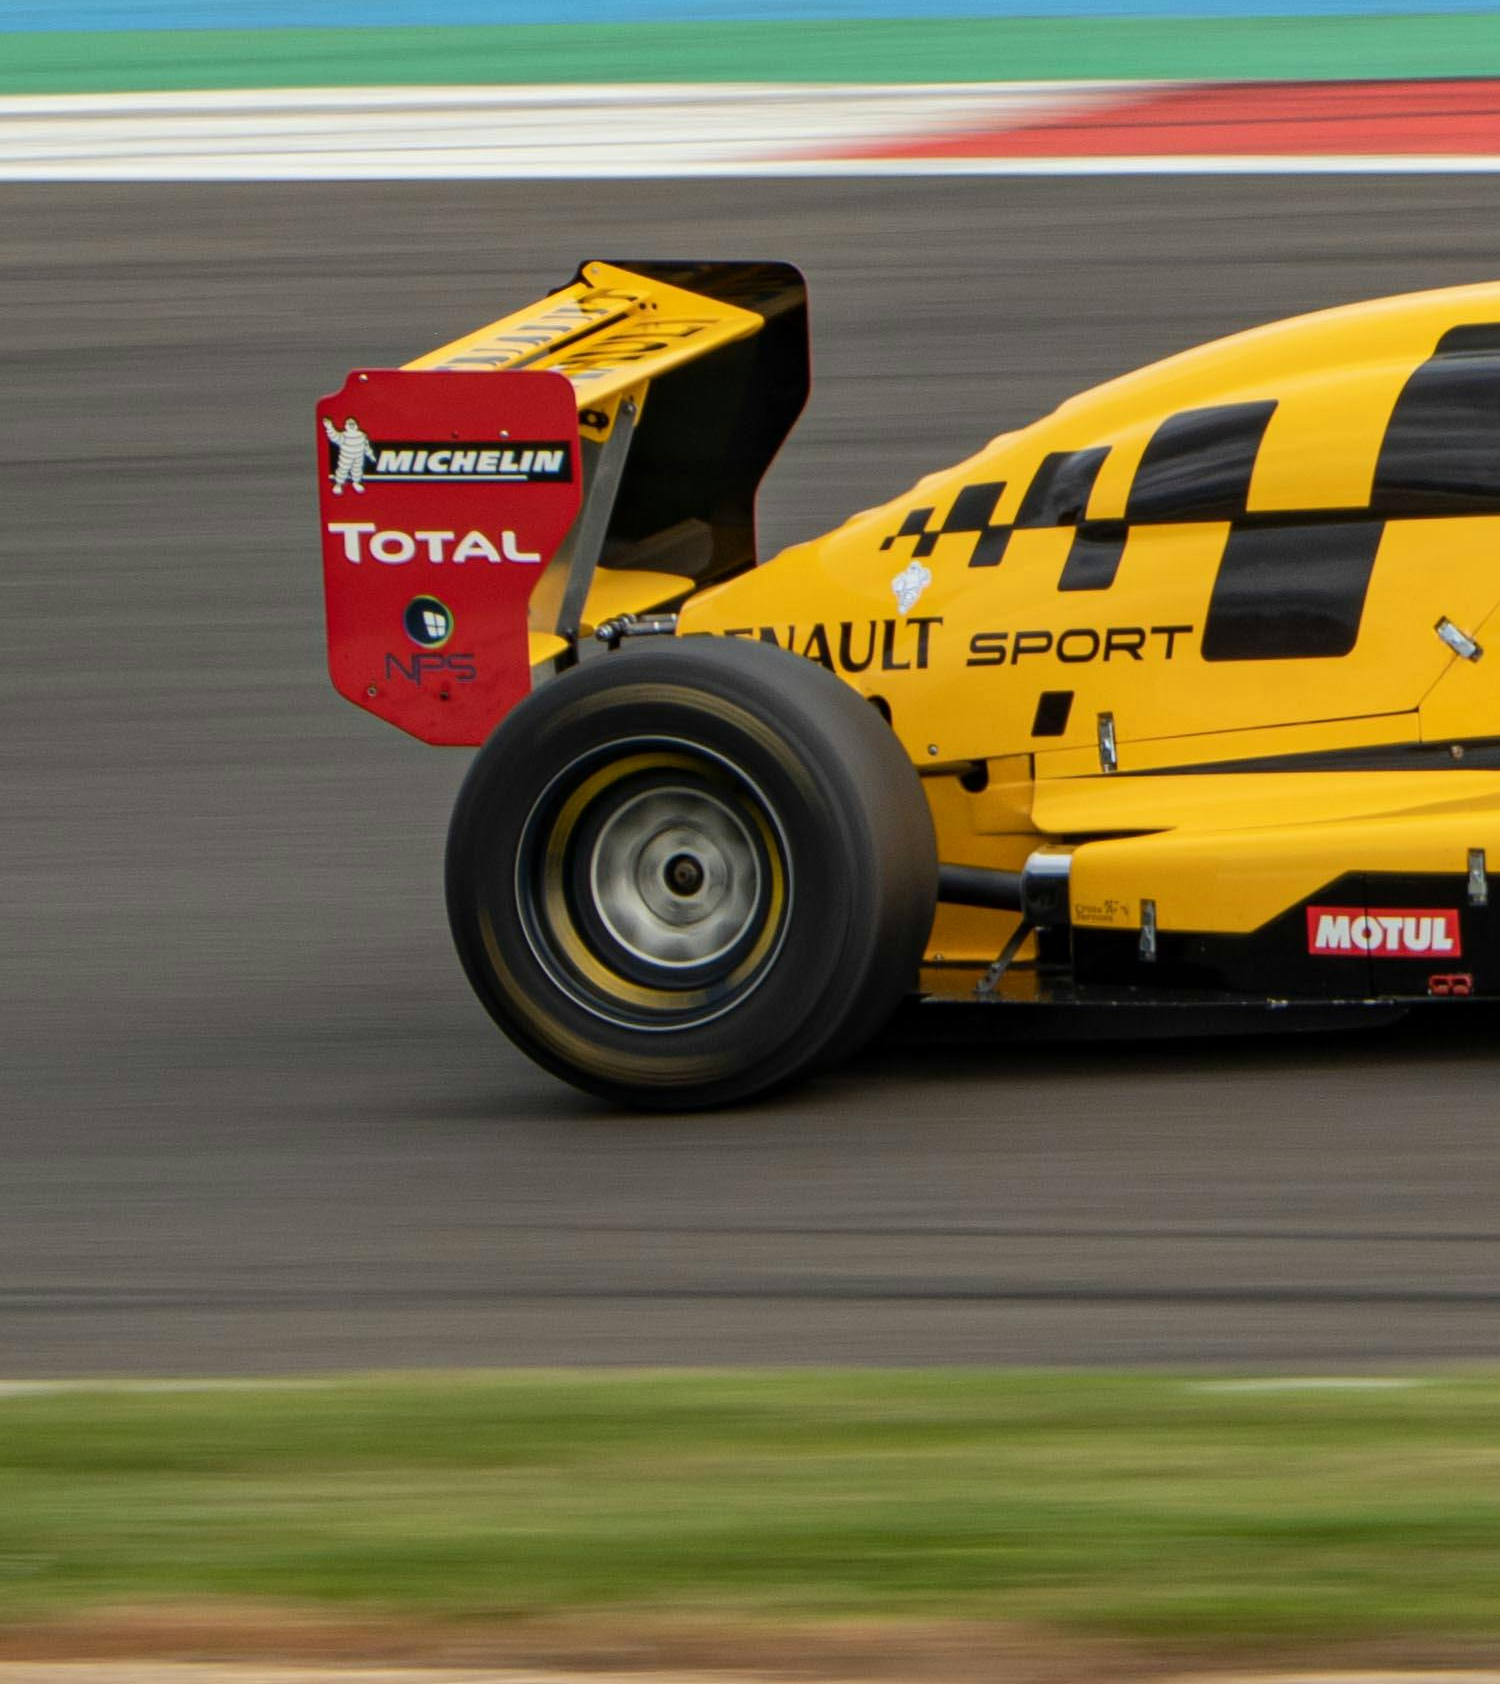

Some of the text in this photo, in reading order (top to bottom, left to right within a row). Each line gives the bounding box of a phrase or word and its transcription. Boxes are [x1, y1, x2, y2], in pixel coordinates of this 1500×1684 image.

[376, 450, 564, 473] MICHELIN
[328, 522, 541, 564] TOTAL
[966, 625, 1193, 666] SPORT
[384, 652, 477, 687] NPS
[1315, 915, 1453, 951] MOTUL
